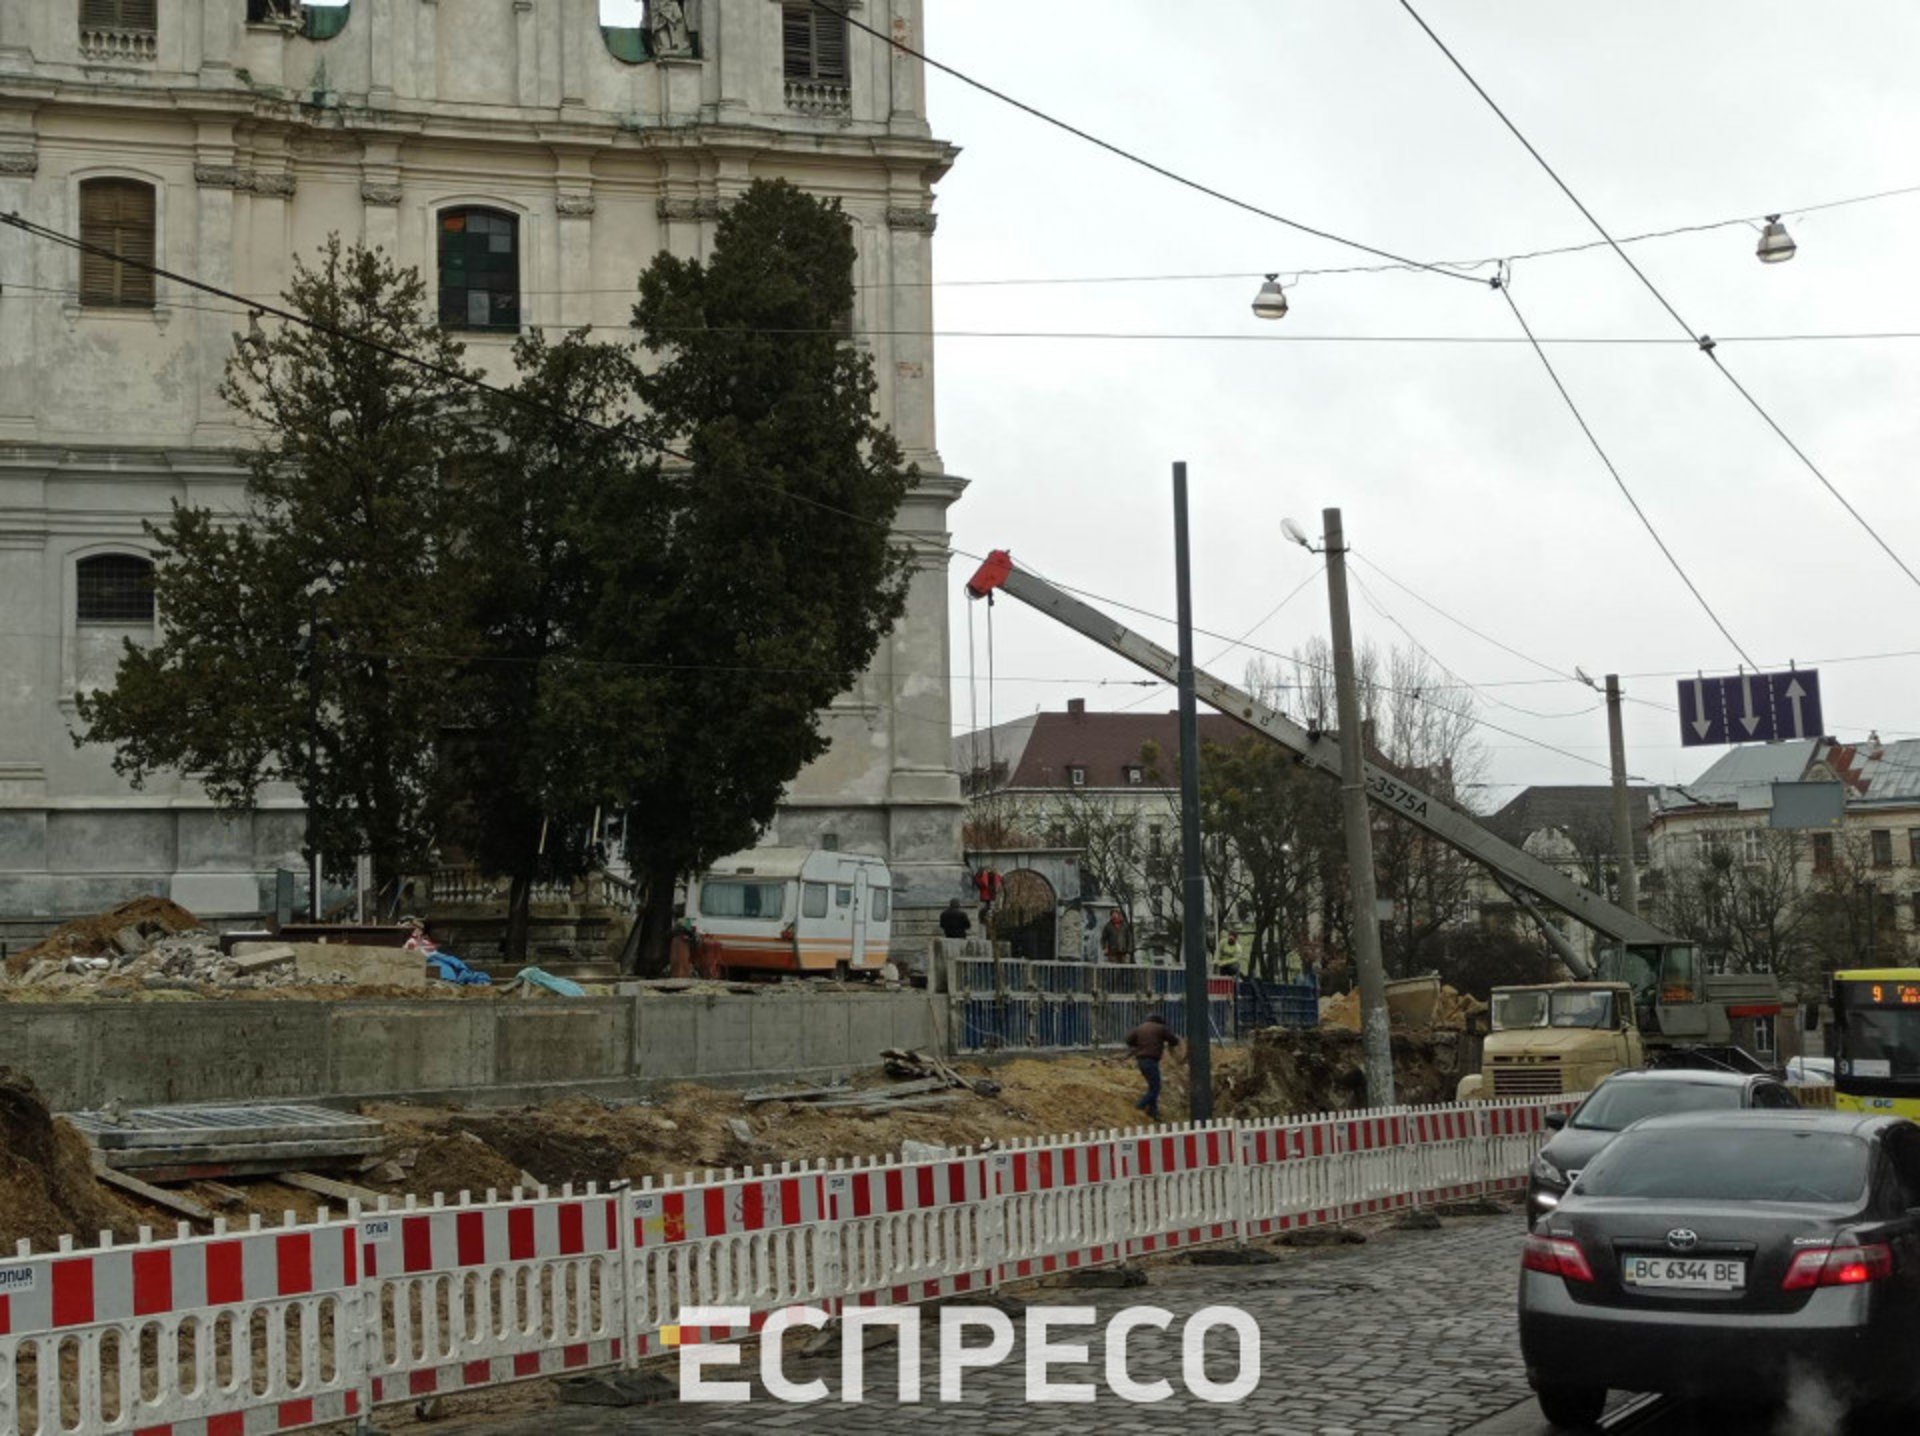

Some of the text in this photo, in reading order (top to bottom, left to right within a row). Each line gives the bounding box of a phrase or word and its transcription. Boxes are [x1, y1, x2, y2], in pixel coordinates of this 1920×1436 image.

[1872, 984, 1882, 1003] 9
[1635, 1260, 1739, 1282] BC 6344 BE
